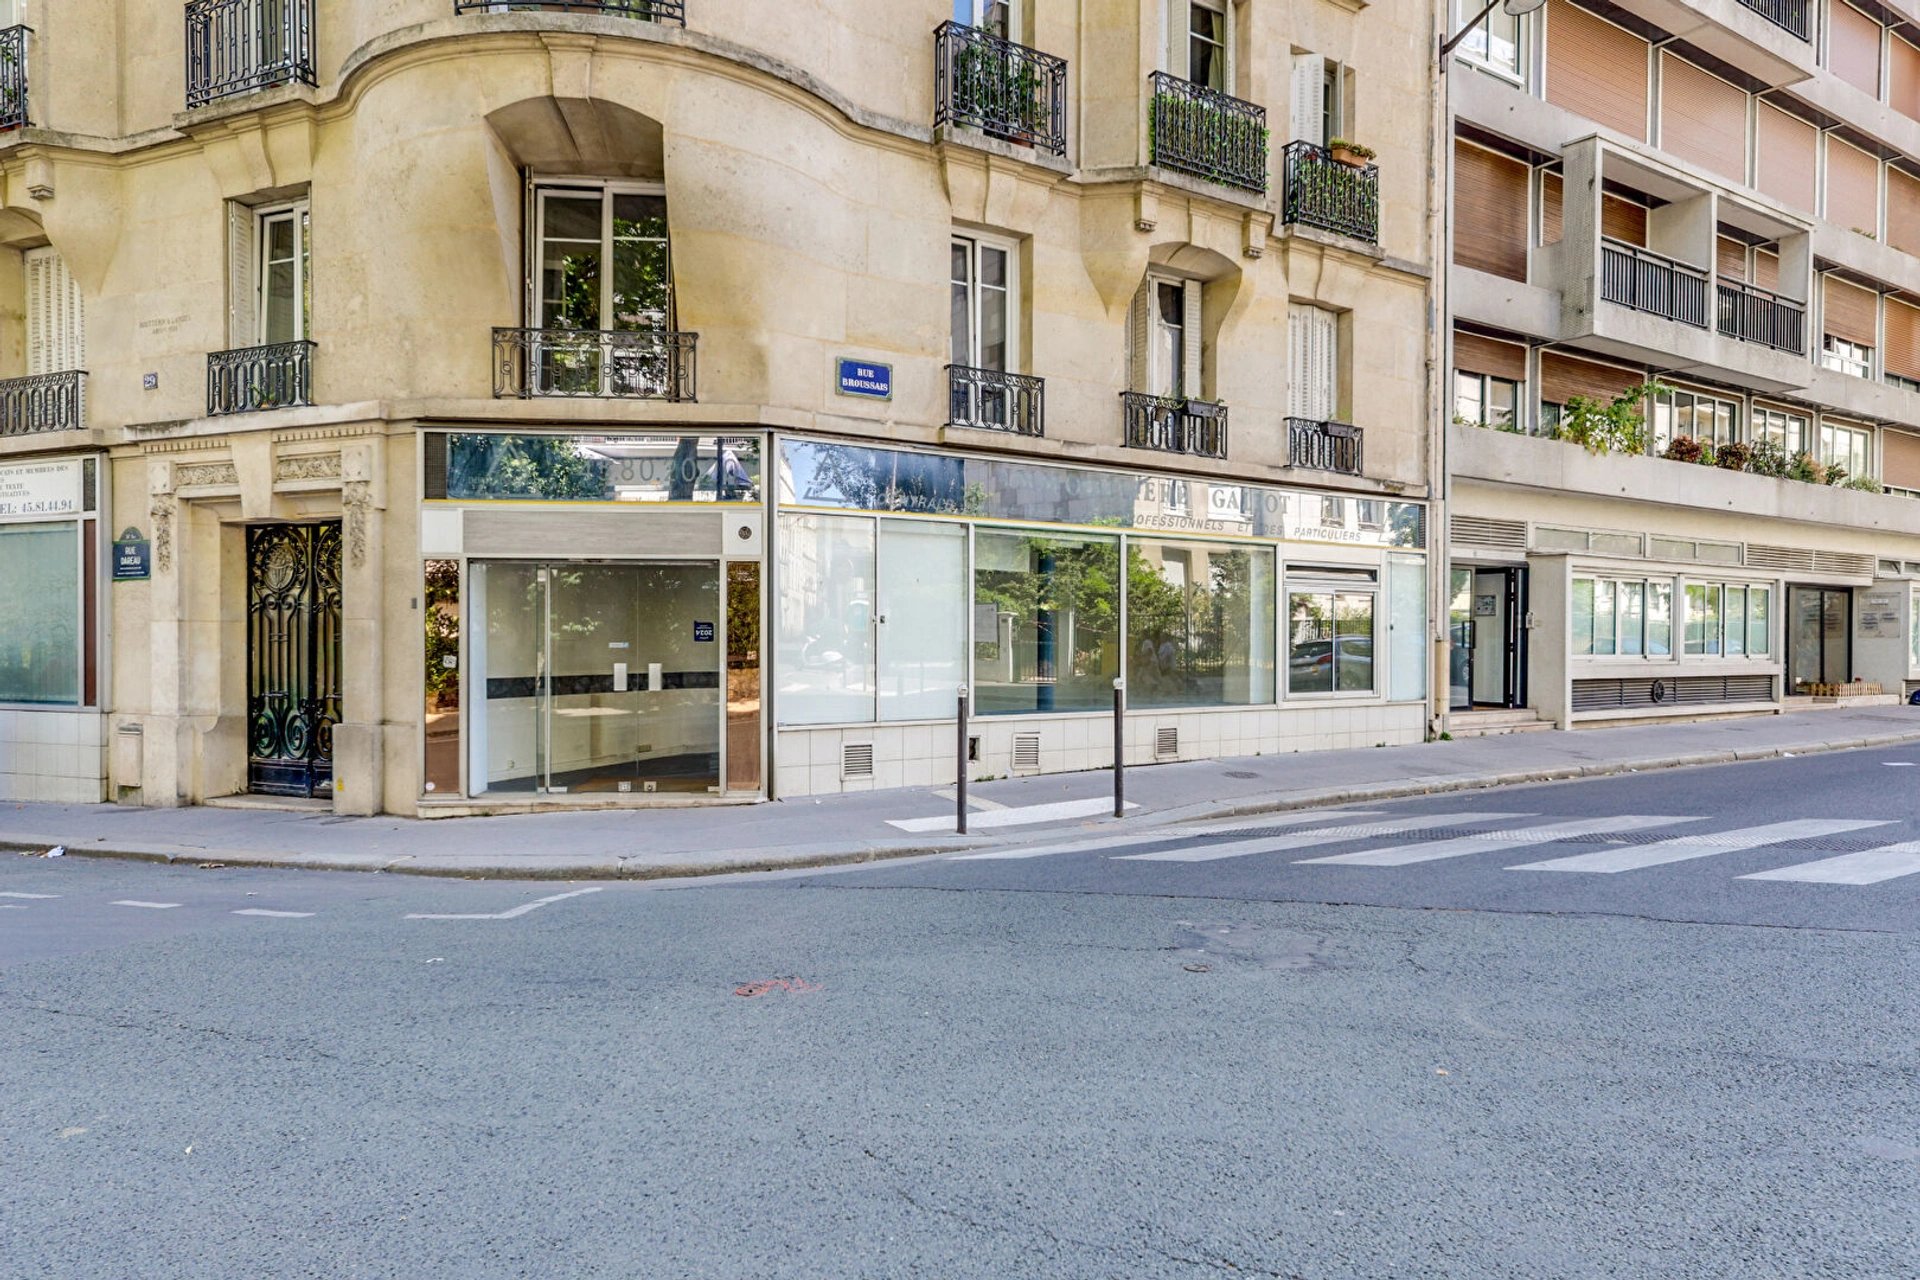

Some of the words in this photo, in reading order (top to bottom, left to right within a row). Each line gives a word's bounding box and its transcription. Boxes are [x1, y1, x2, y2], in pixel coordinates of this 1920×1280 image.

[857, 368, 875, 378] RUE
[144, 374, 156, 387] 29
[842, 377, 888, 391] BROUSSAIS
[1238, 523, 1250, 532] ET
[1294, 527, 1361, 541] PARTICULIERS
